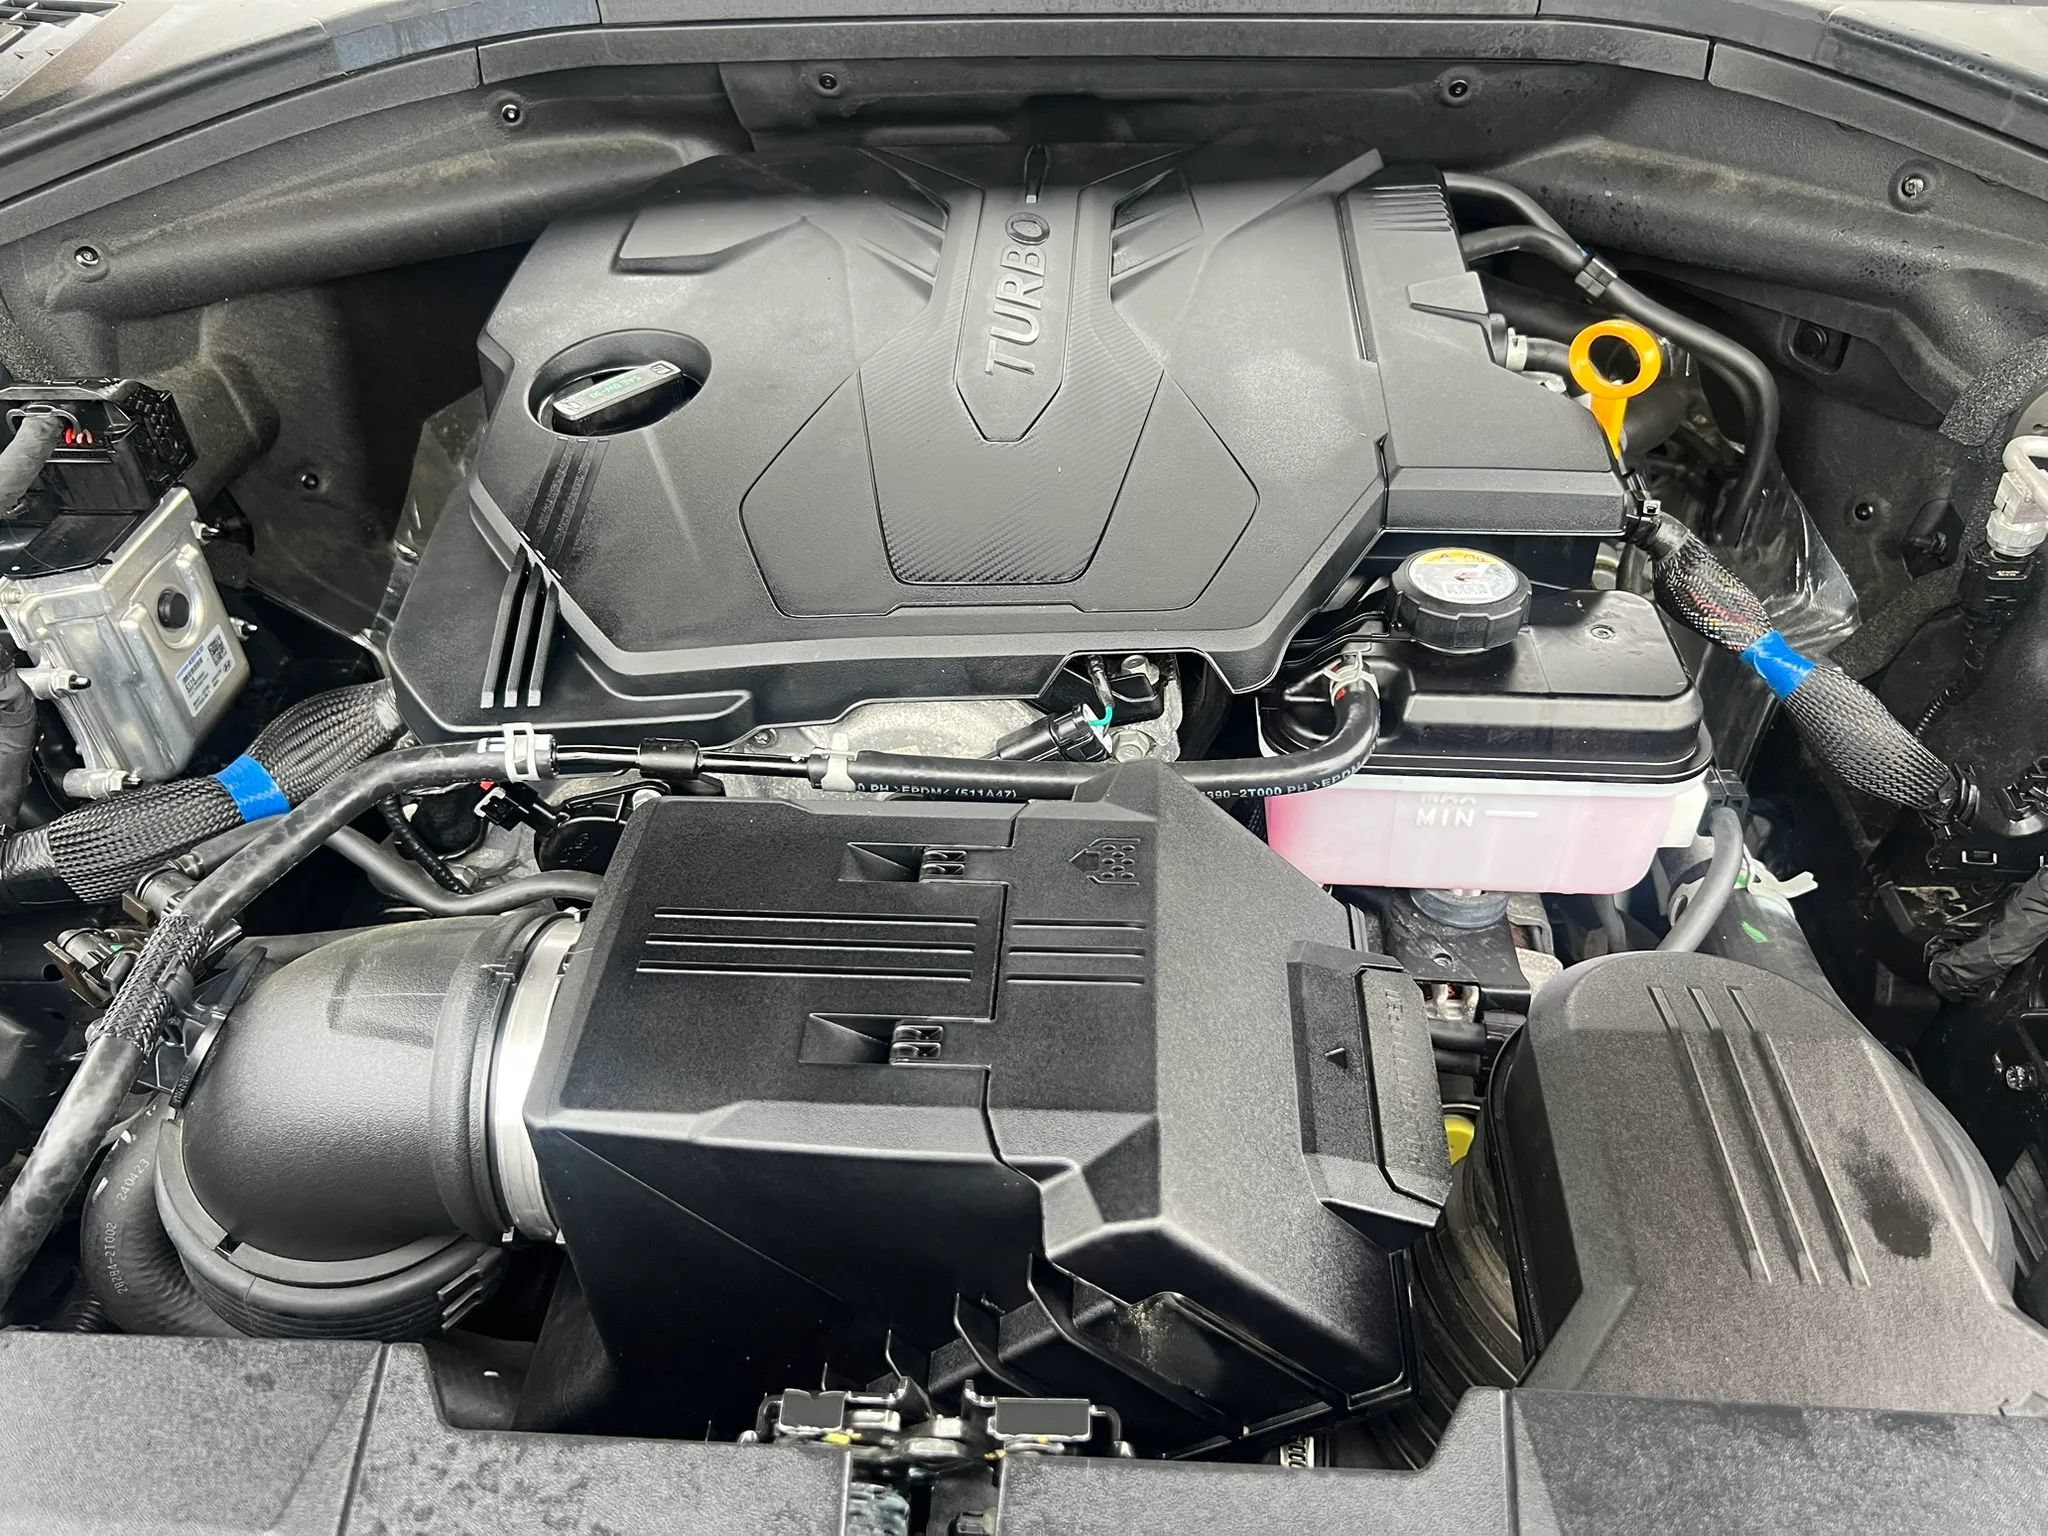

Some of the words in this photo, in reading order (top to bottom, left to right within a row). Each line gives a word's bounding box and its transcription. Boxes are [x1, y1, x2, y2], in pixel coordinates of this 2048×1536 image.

[984, 211, 1051, 376] TURBO
[1200, 786, 1282, 799] 390-2T000
[1416, 807, 1476, 828] MIN
